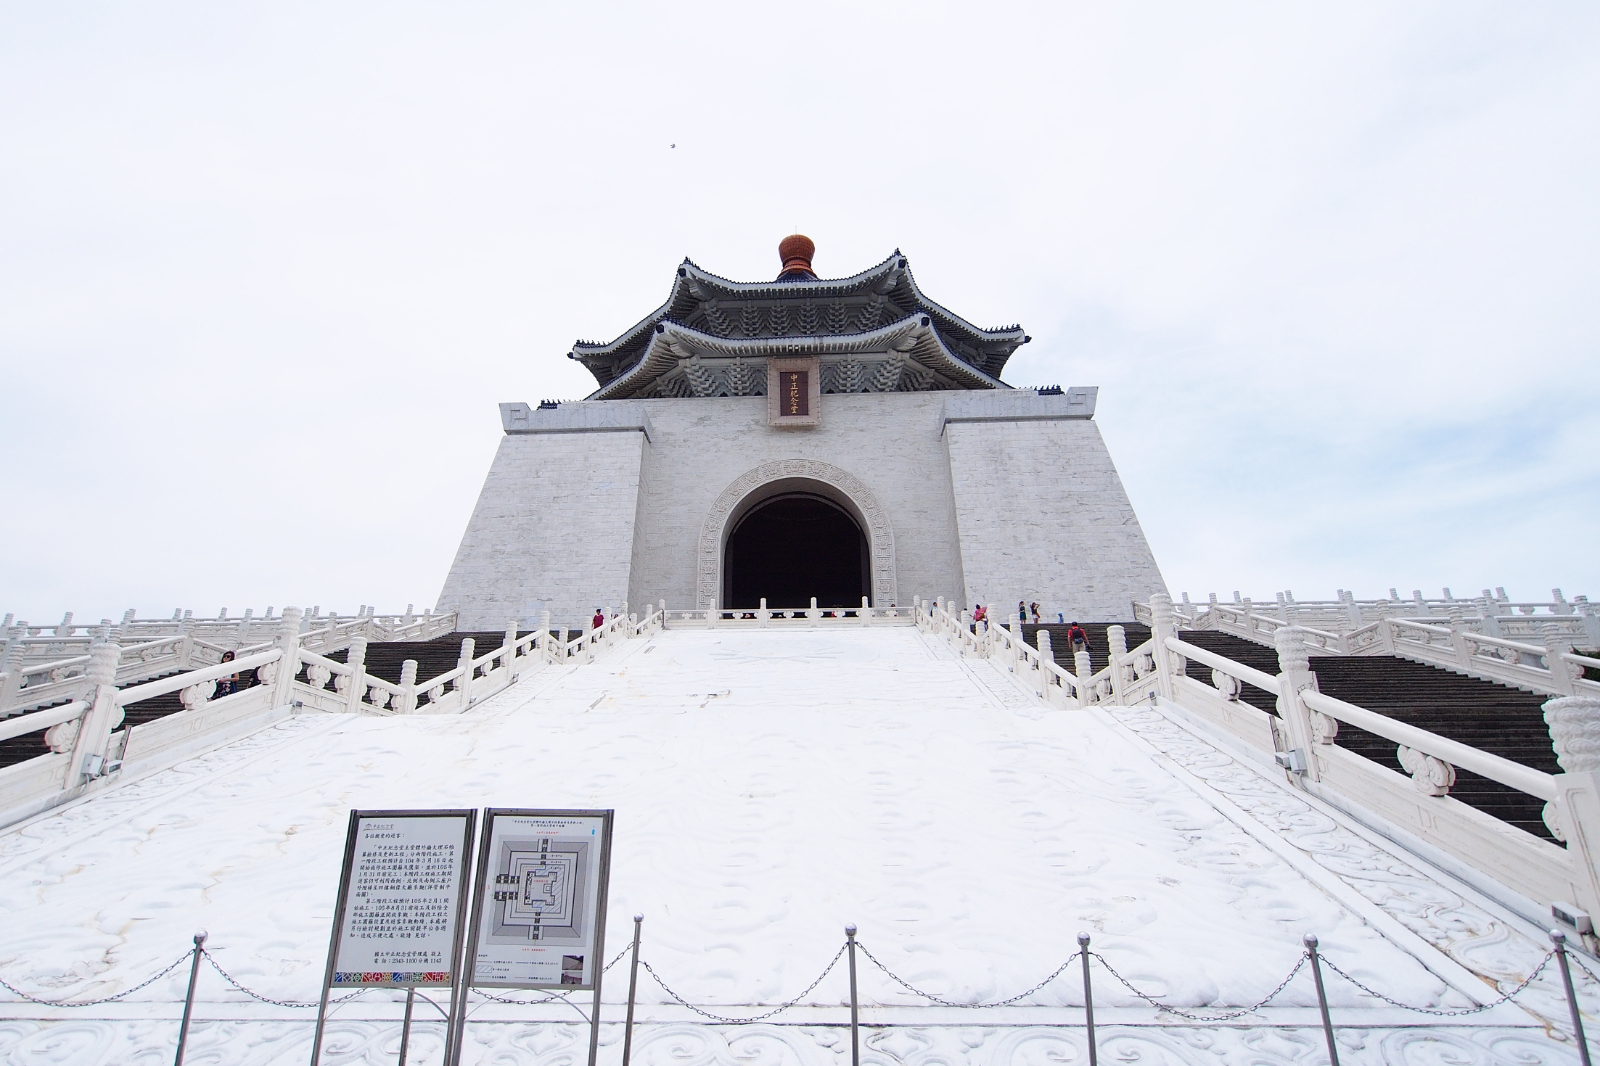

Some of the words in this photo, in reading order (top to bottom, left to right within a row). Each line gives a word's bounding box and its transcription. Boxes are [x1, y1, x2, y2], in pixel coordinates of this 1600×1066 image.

[790, 374, 798, 414] 中正紀念堂
